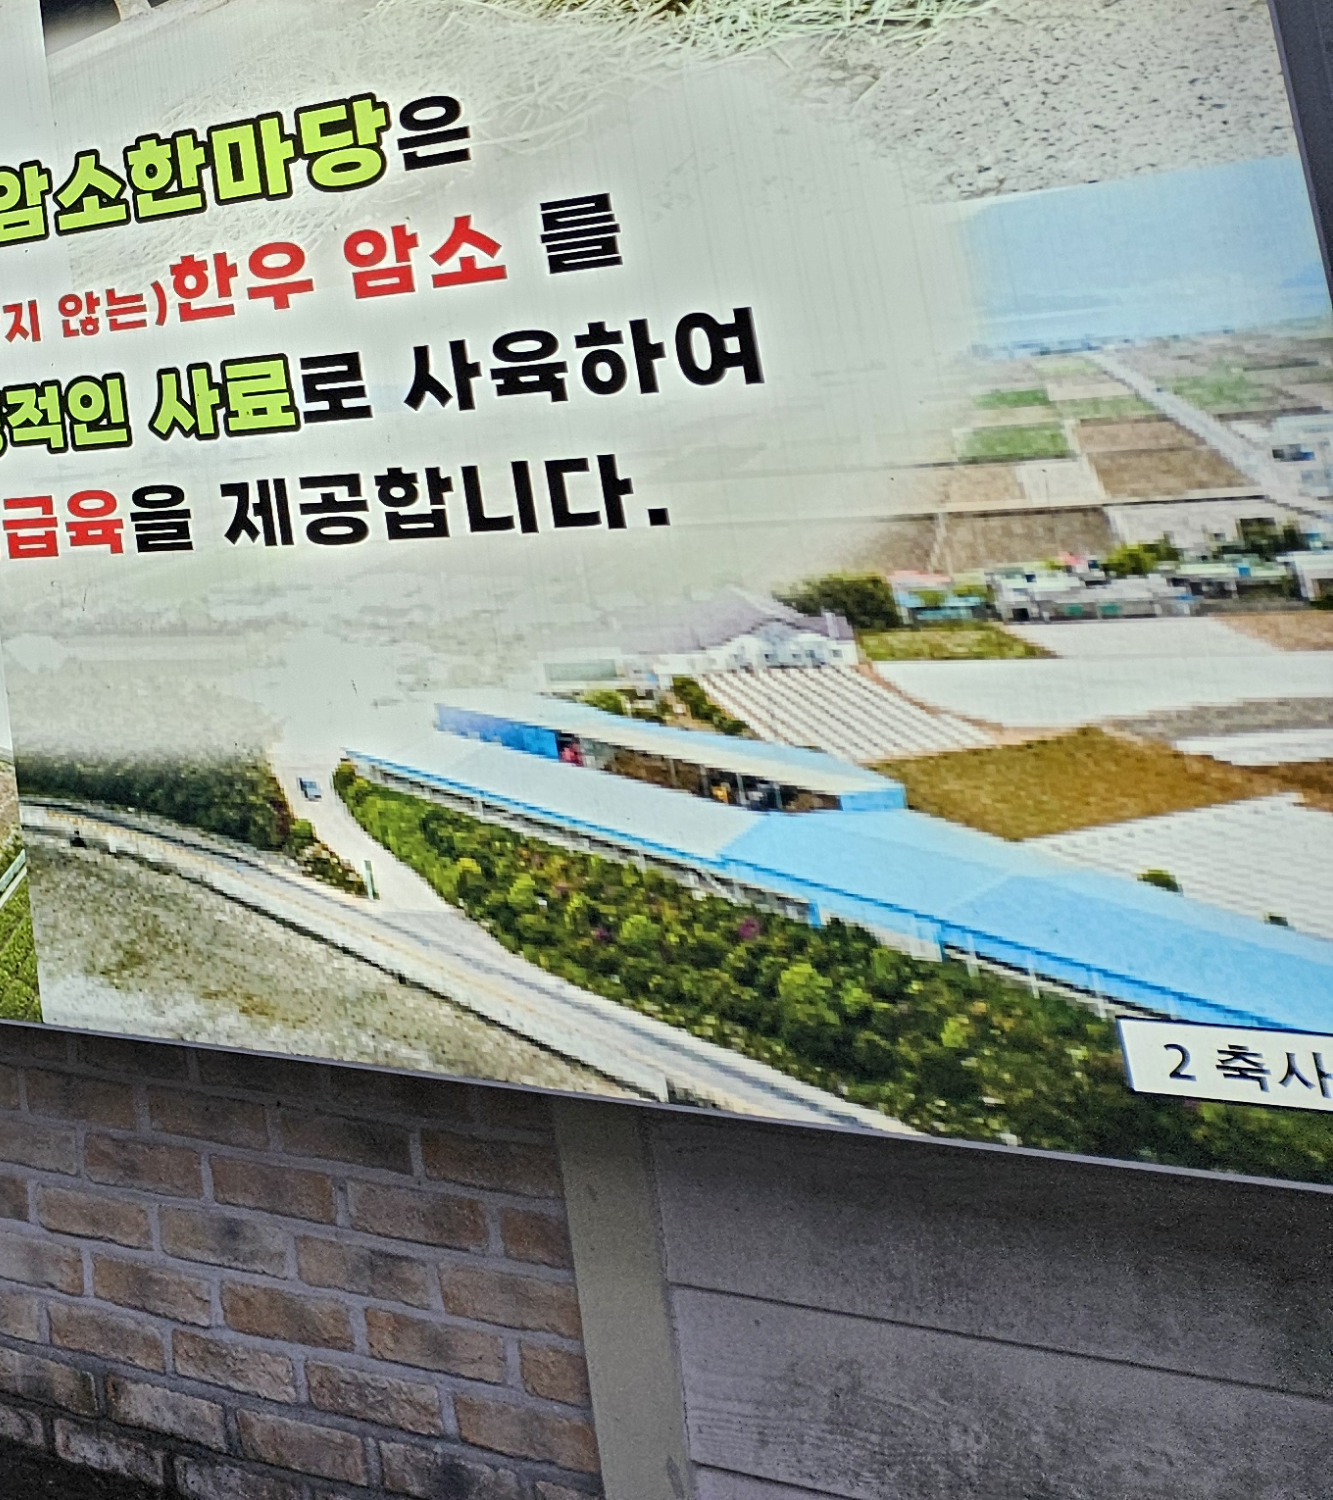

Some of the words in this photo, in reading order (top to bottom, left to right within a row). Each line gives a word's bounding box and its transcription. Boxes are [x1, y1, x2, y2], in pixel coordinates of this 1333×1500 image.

[342, 214, 508, 300] 암소
[539, 192, 622, 275] 를
[149, 350, 374, 441] 사료로
[402, 306, 765, 412] 사육하여
[219, 453, 672, 549] 제공합니다.
[1163, 1043, 1197, 1082] 2
[1215, 1043, 1333, 1099] 축사
